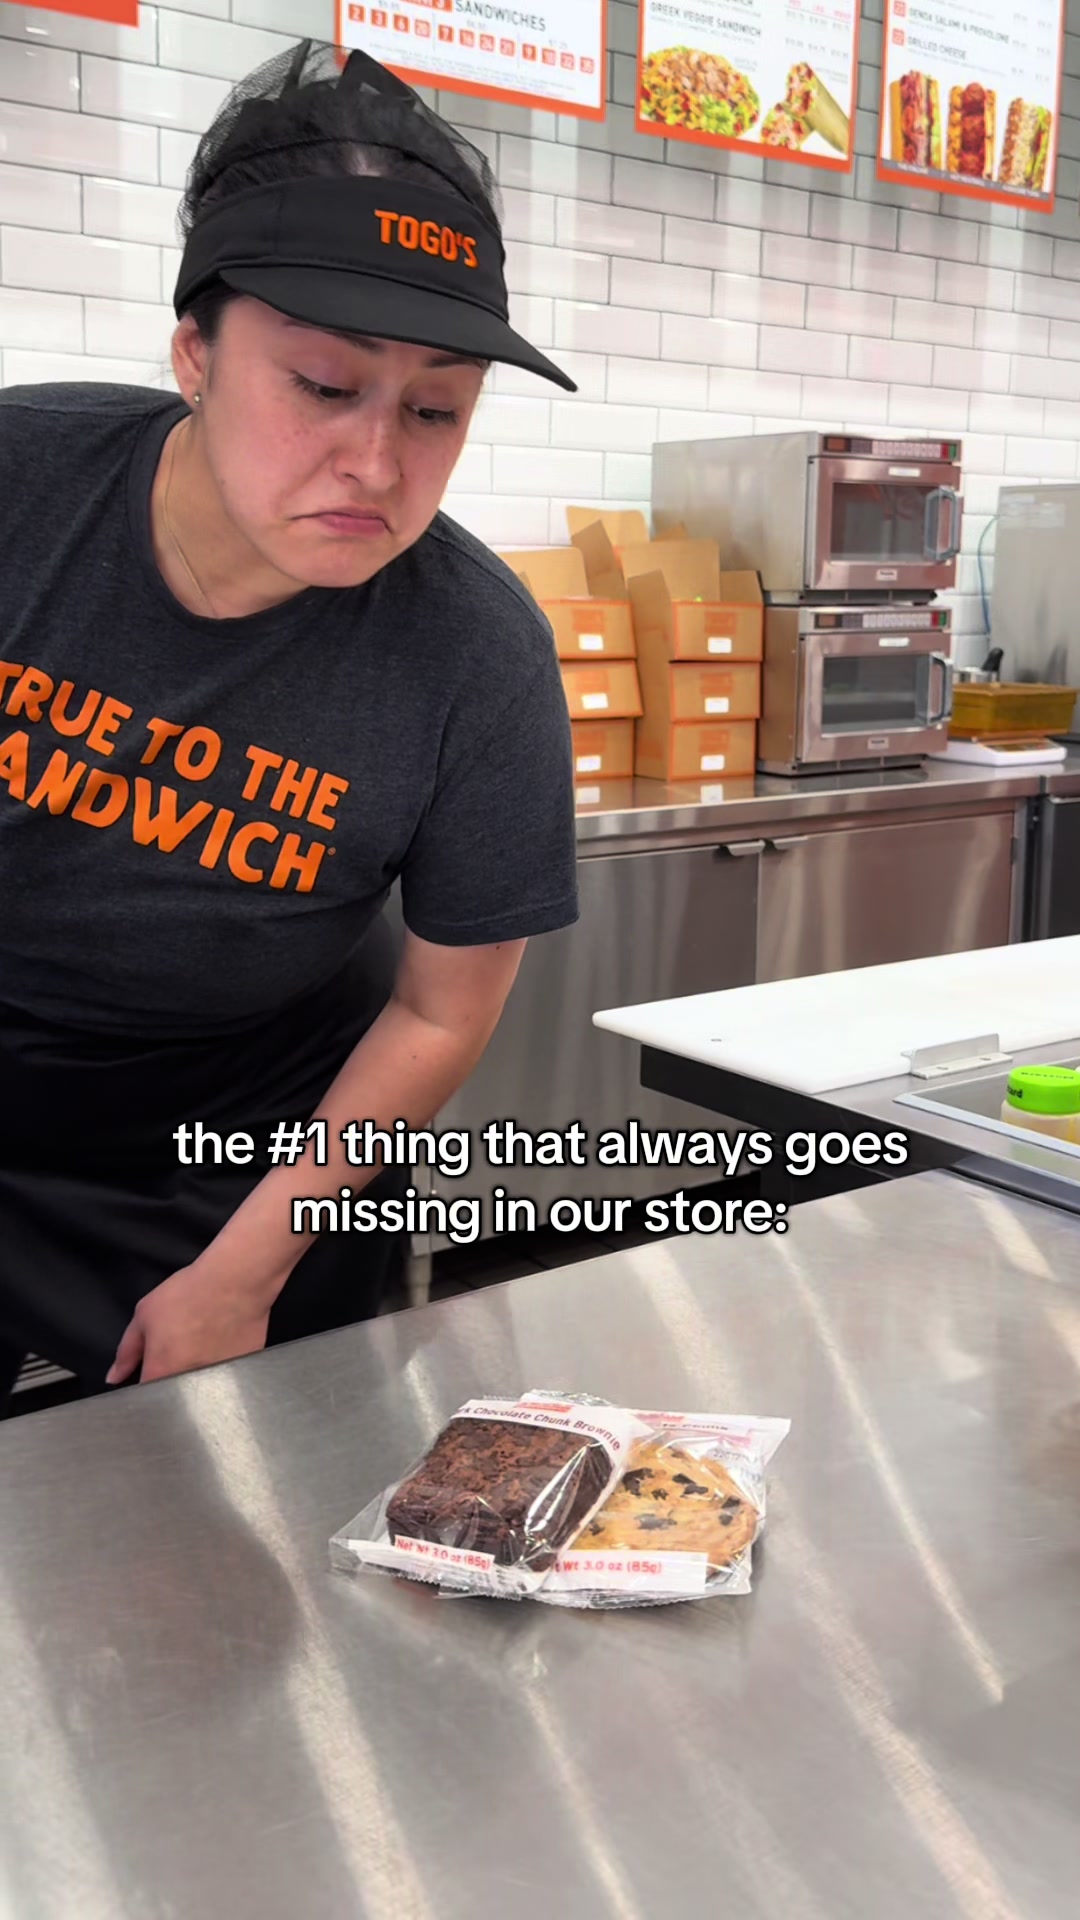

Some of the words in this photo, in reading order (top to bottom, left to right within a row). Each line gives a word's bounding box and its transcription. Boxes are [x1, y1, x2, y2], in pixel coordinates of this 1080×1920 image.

[455, 0, 546, 32] SANDWICHES
[651, 2, 679, 17] GREEK
[683, 10, 714, 27] VEGGIE
[717, 18, 761, 36] SANDWICH
[935, 14, 960, 29] SALAMI
[970, 24, 1009, 44] PROVOLONE
[908, 36, 938, 52] GRILLED
[939, 44, 967, 60] CHEESE
[374, 208, 478, 268] TOGO'S
[0, 660, 133, 757] TRUE
[140, 717, 222, 781] TO
[241, 745, 349, 830] THE
[0, 730, 327, 892] ANDWICH
[473, 1407, 532, 1420] Chocolate
[534, 1413, 571, 1427] Chunk
[573, 1420, 621, 1451] Brownie
[397, 1540, 412, 1551] Net
[564, 1560, 579, 1571] Wt
[608, 1562, 622, 1571] oz
[627, 1560, 664, 1576] (85g)
